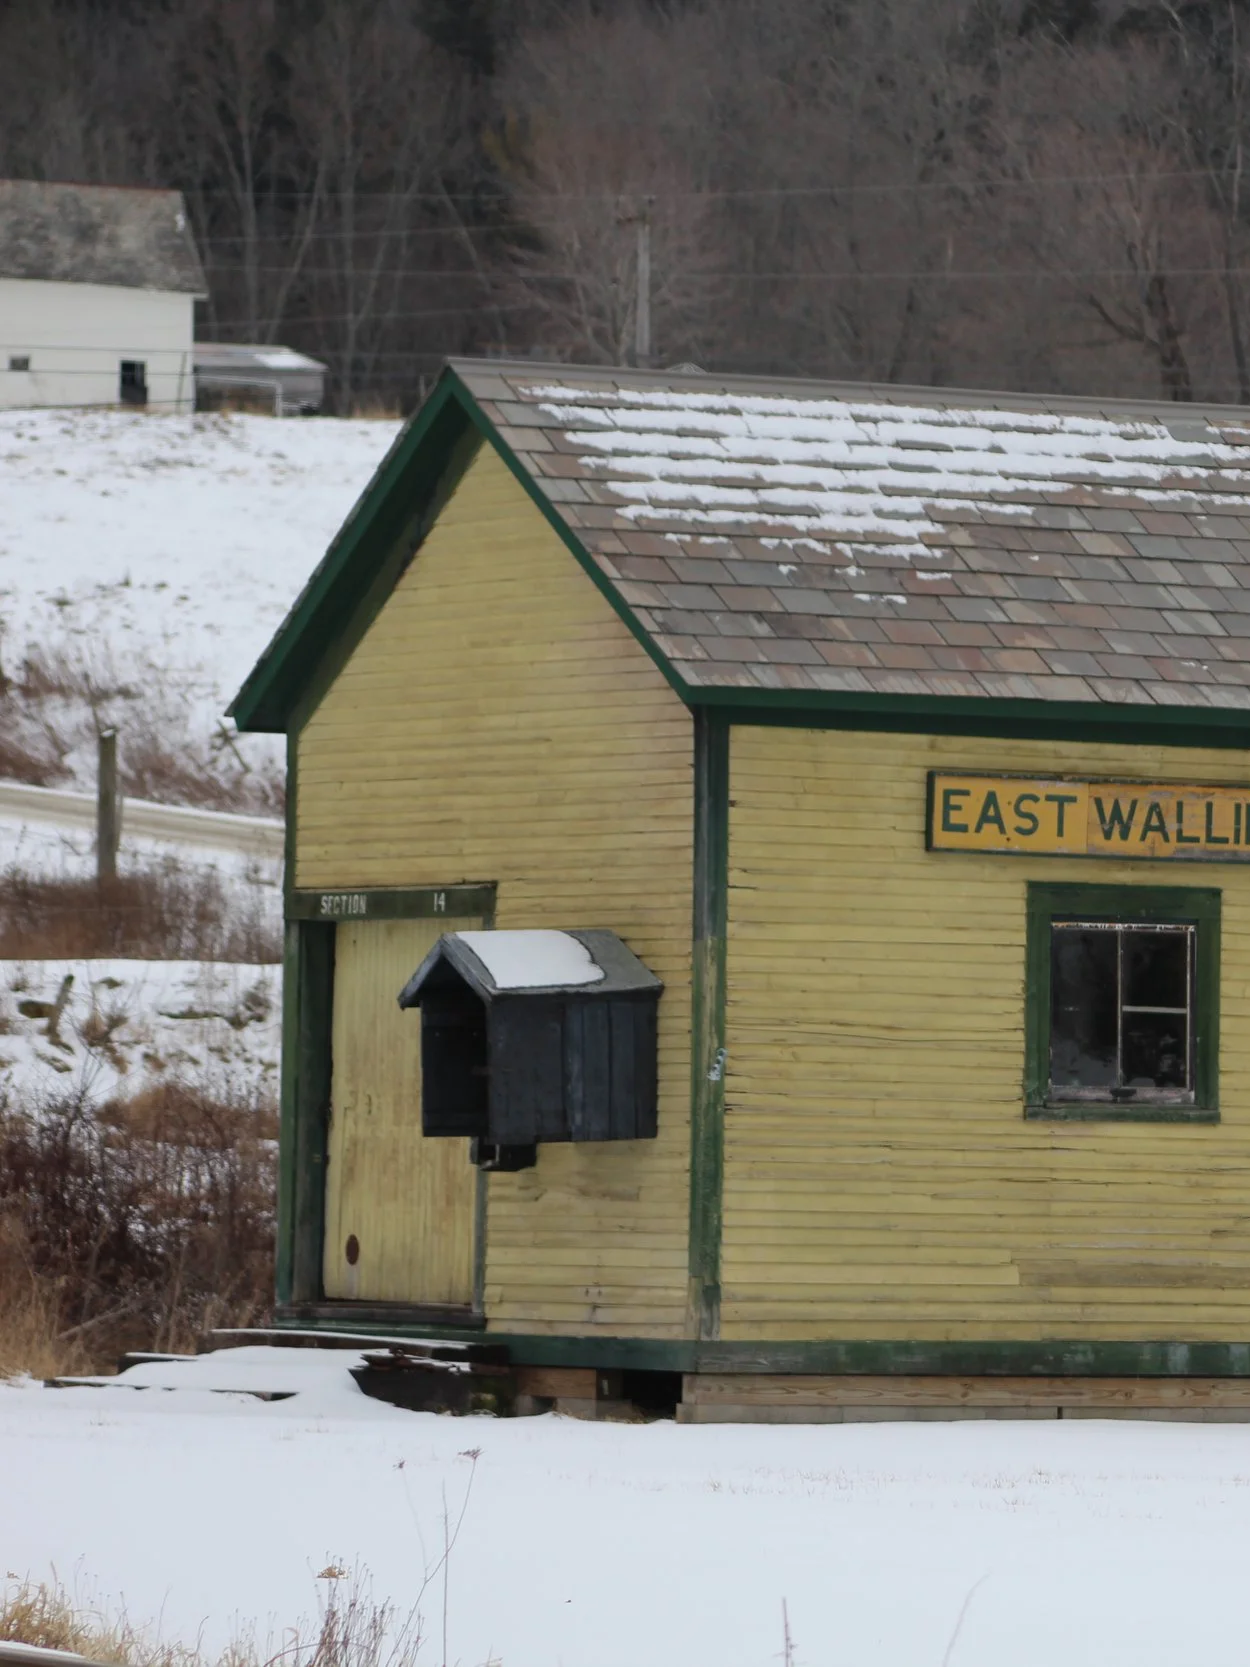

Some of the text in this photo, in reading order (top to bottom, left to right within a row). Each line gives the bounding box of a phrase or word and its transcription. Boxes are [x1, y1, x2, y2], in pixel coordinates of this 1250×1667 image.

[941, 787, 1077, 838] EAST
[320, 892, 446, 915] SECTION 14
